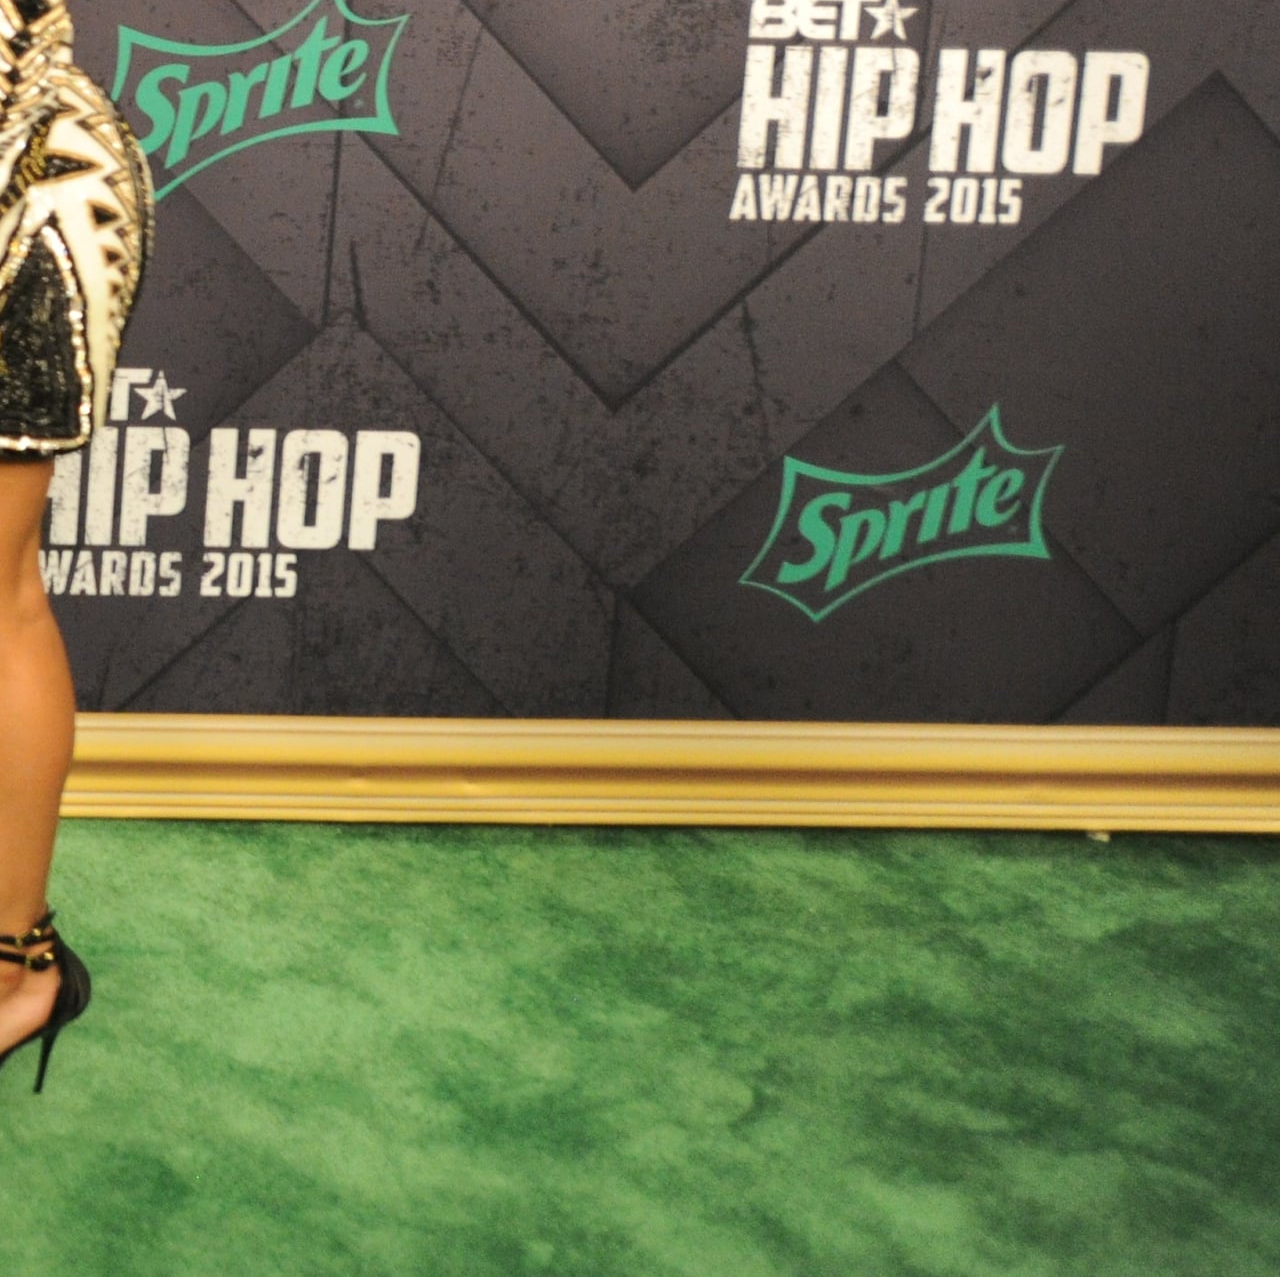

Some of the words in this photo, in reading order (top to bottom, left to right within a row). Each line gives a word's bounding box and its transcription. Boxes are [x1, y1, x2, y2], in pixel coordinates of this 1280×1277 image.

[135, 15, 371, 170] Sprite
[738, 45, 919, 170] HIP
[929, 48, 1149, 175] HOP
[729, 174, 907, 223] AWARDS
[924, 177, 1021, 224] 2015
[204, 428, 420, 550] HOP
[775, 445, 1026, 591] Sprite
[37, 548, 182, 596] WARDS
[199, 552, 297, 597] 2015
